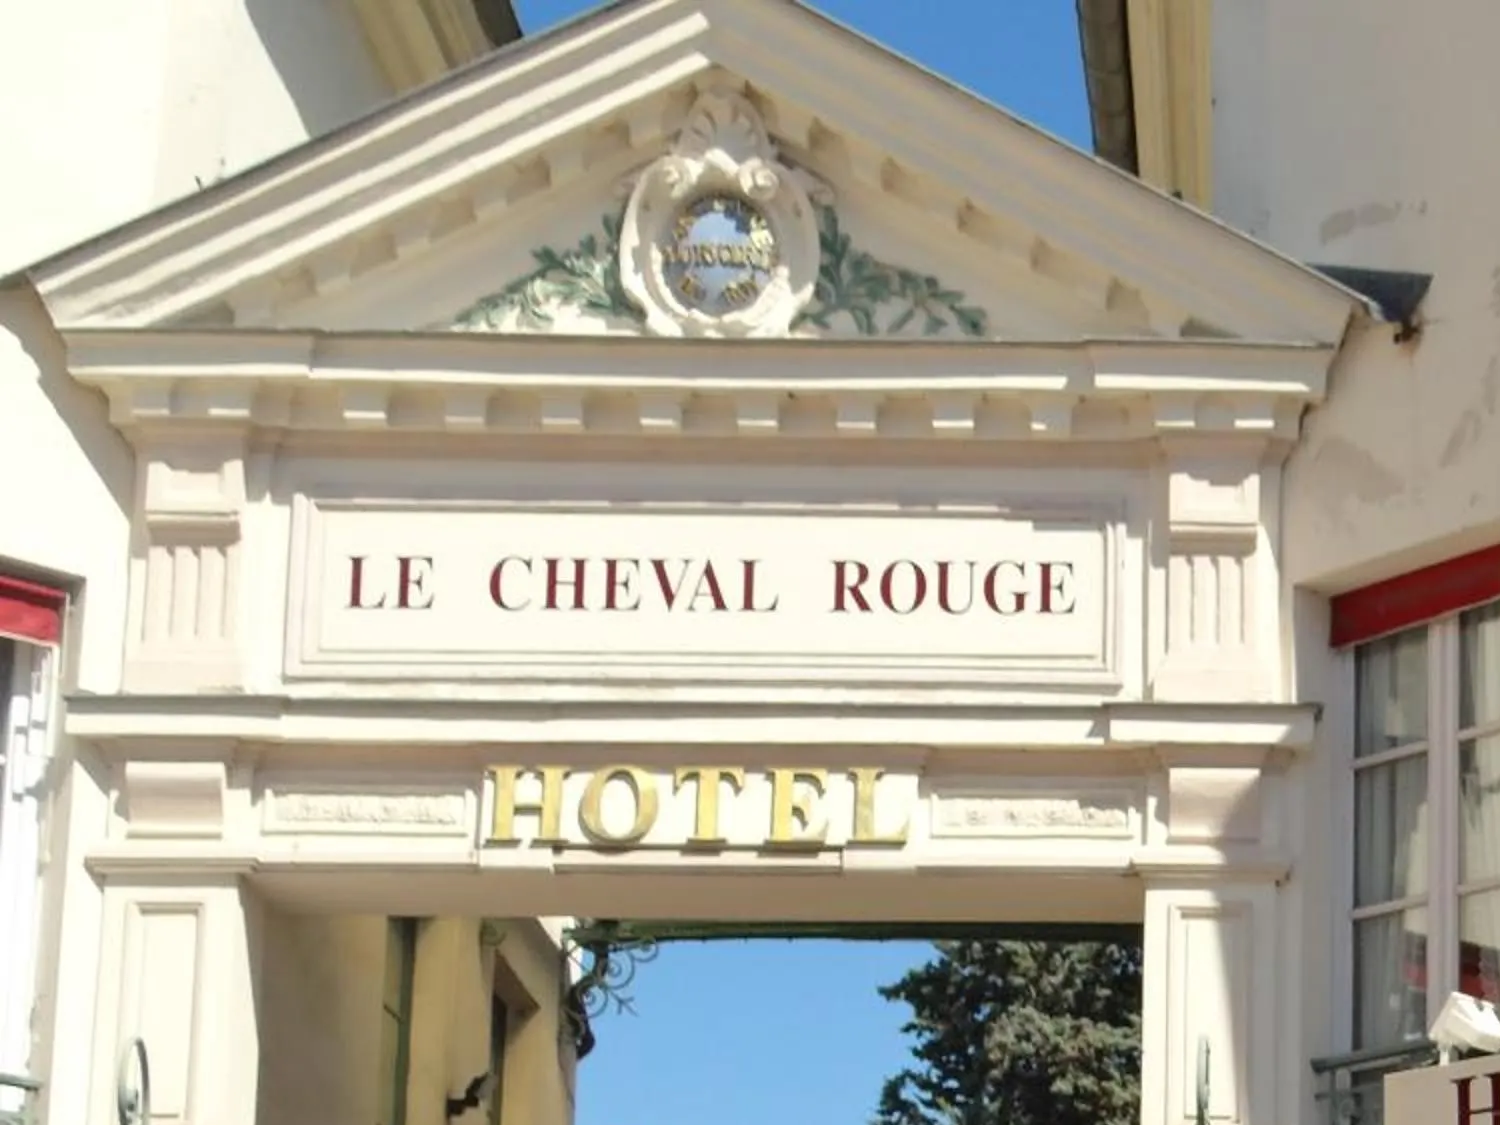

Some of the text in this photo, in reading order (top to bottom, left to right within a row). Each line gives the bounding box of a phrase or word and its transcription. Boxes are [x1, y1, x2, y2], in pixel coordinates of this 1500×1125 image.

[345, 555, 1077, 615] LE CHEVAL ROUGE
[483, 765, 912, 854] HOTEL
